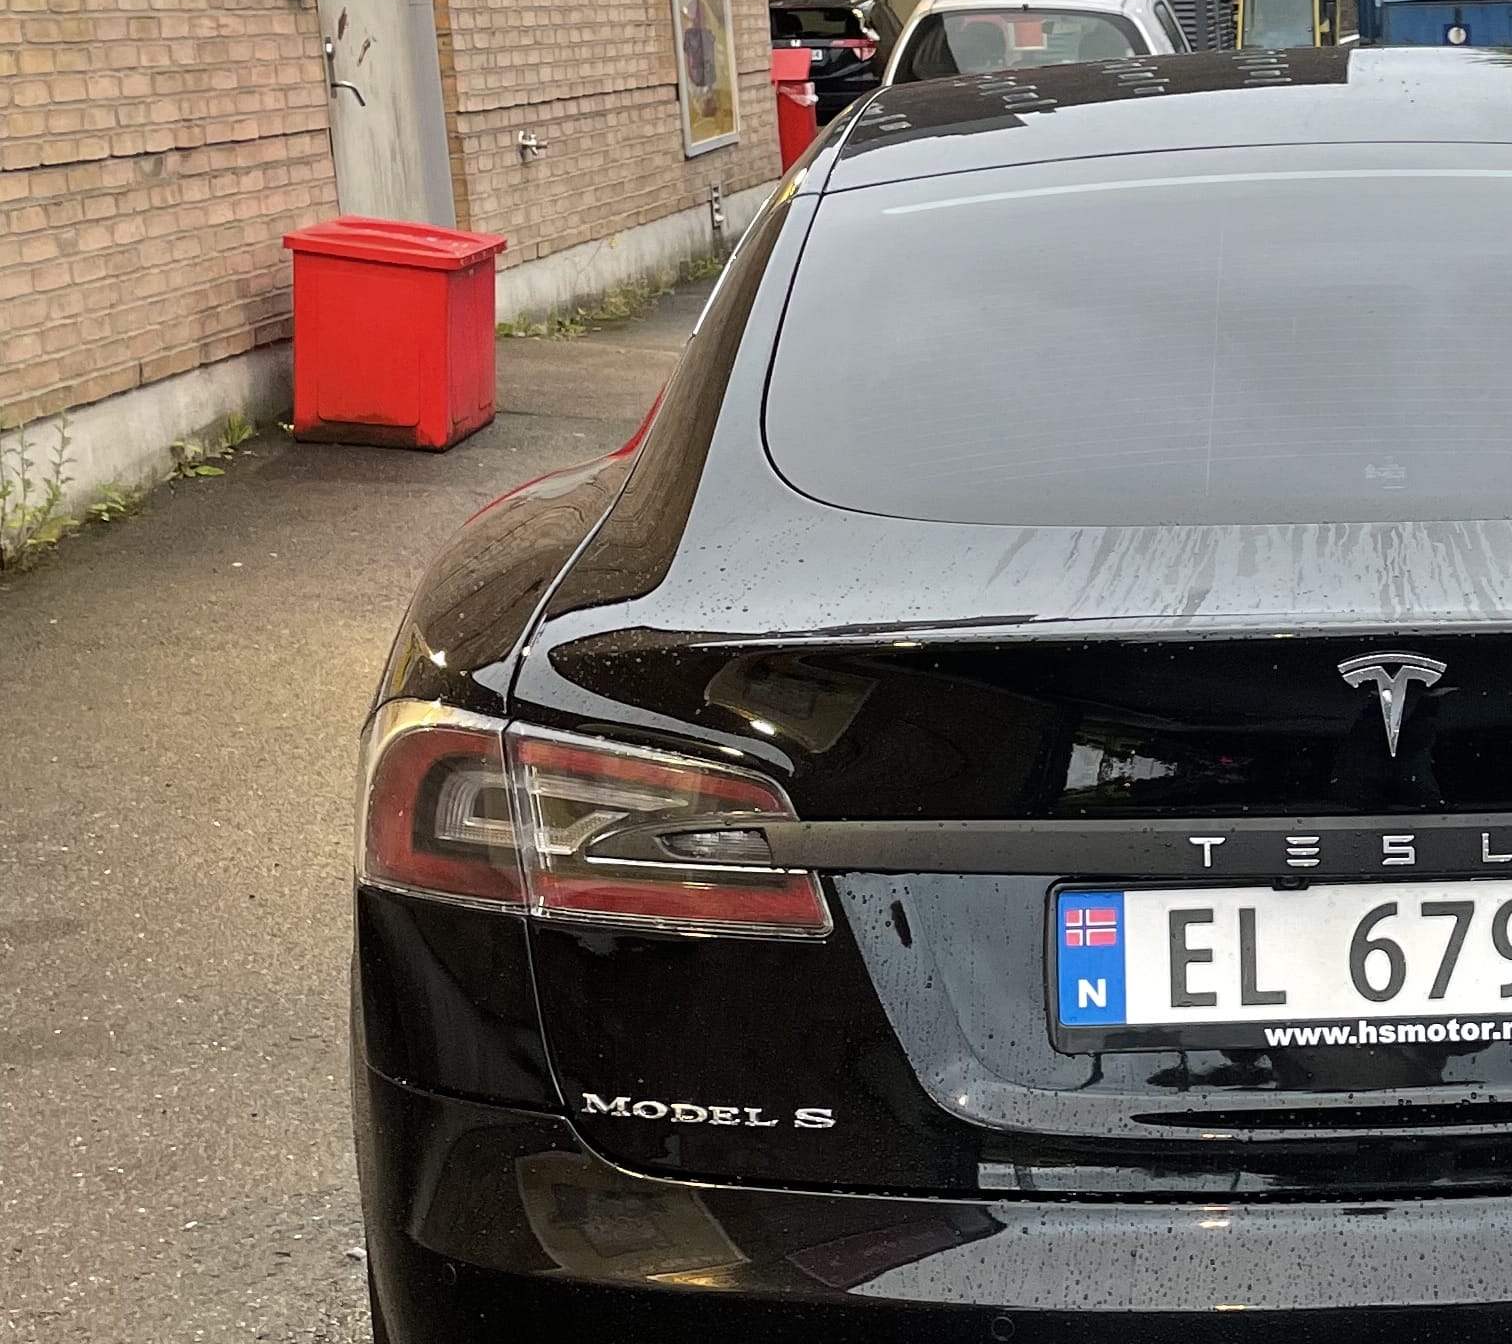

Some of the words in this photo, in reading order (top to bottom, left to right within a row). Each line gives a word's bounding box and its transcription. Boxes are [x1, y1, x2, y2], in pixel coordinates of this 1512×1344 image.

[1169, 907, 1287, 1008] EL
[1078, 978, 1107, 1008] N
[580, 1093, 779, 1127] MODEL
[794, 1108, 837, 1128] S
